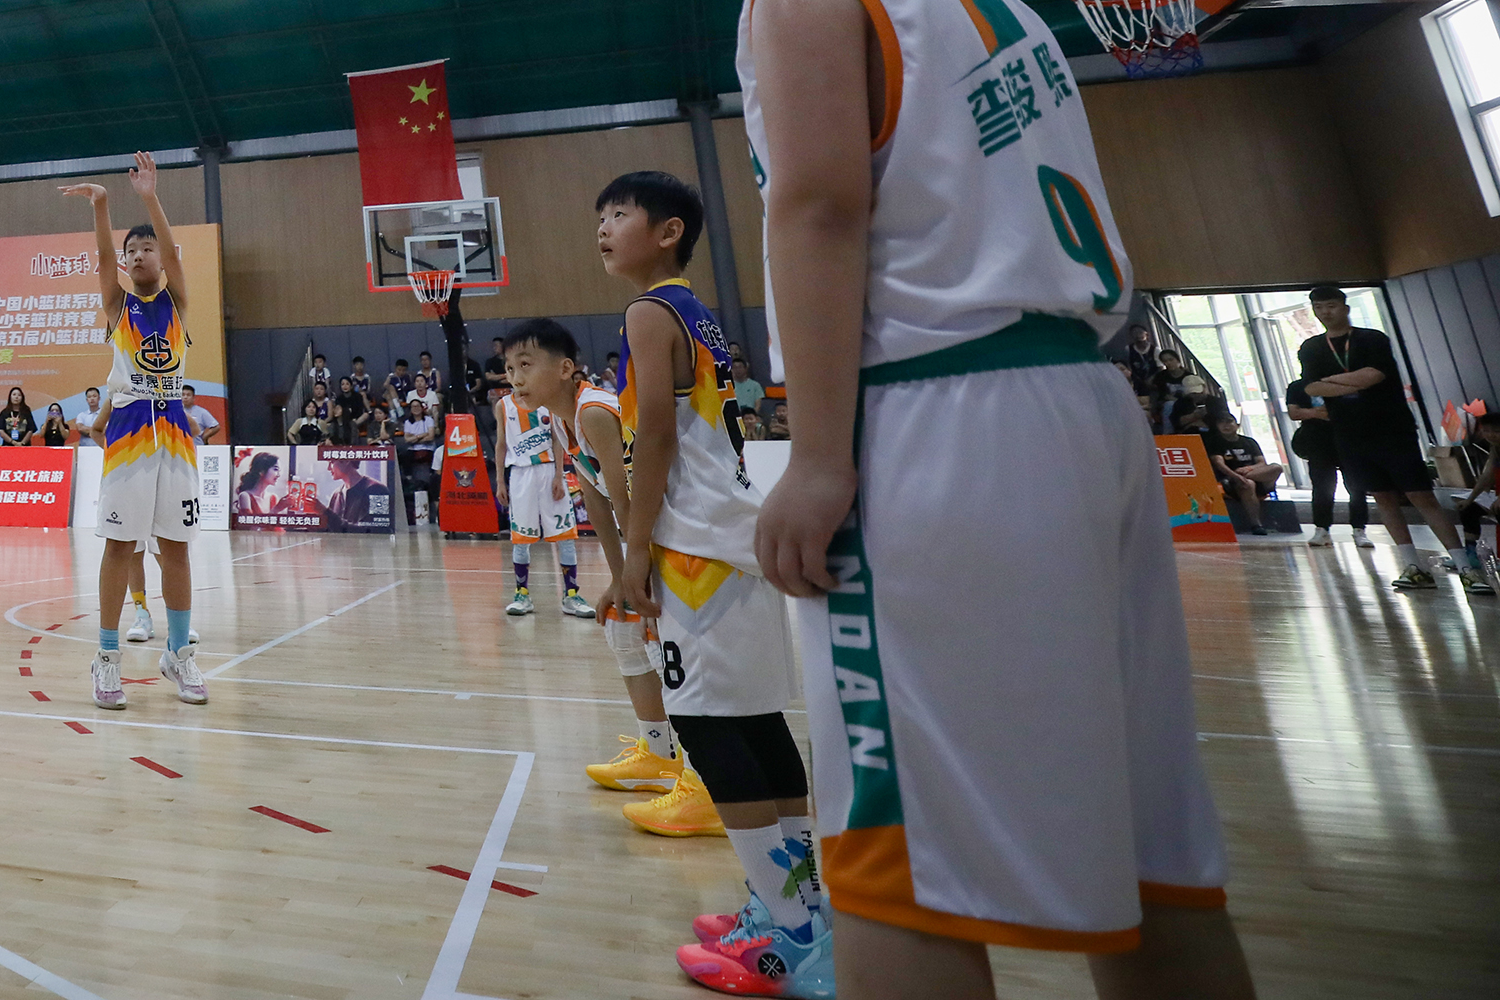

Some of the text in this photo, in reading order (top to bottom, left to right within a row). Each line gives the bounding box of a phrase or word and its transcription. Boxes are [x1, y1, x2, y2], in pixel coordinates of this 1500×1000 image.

[1037, 164, 1124, 316] 9
[322, 450, 389, 459] 树莓复合果汁饮料
[279, 516, 320, 526] 轻松无负担
[553, 514, 571, 530] 24
[663, 641, 686, 690] 8
